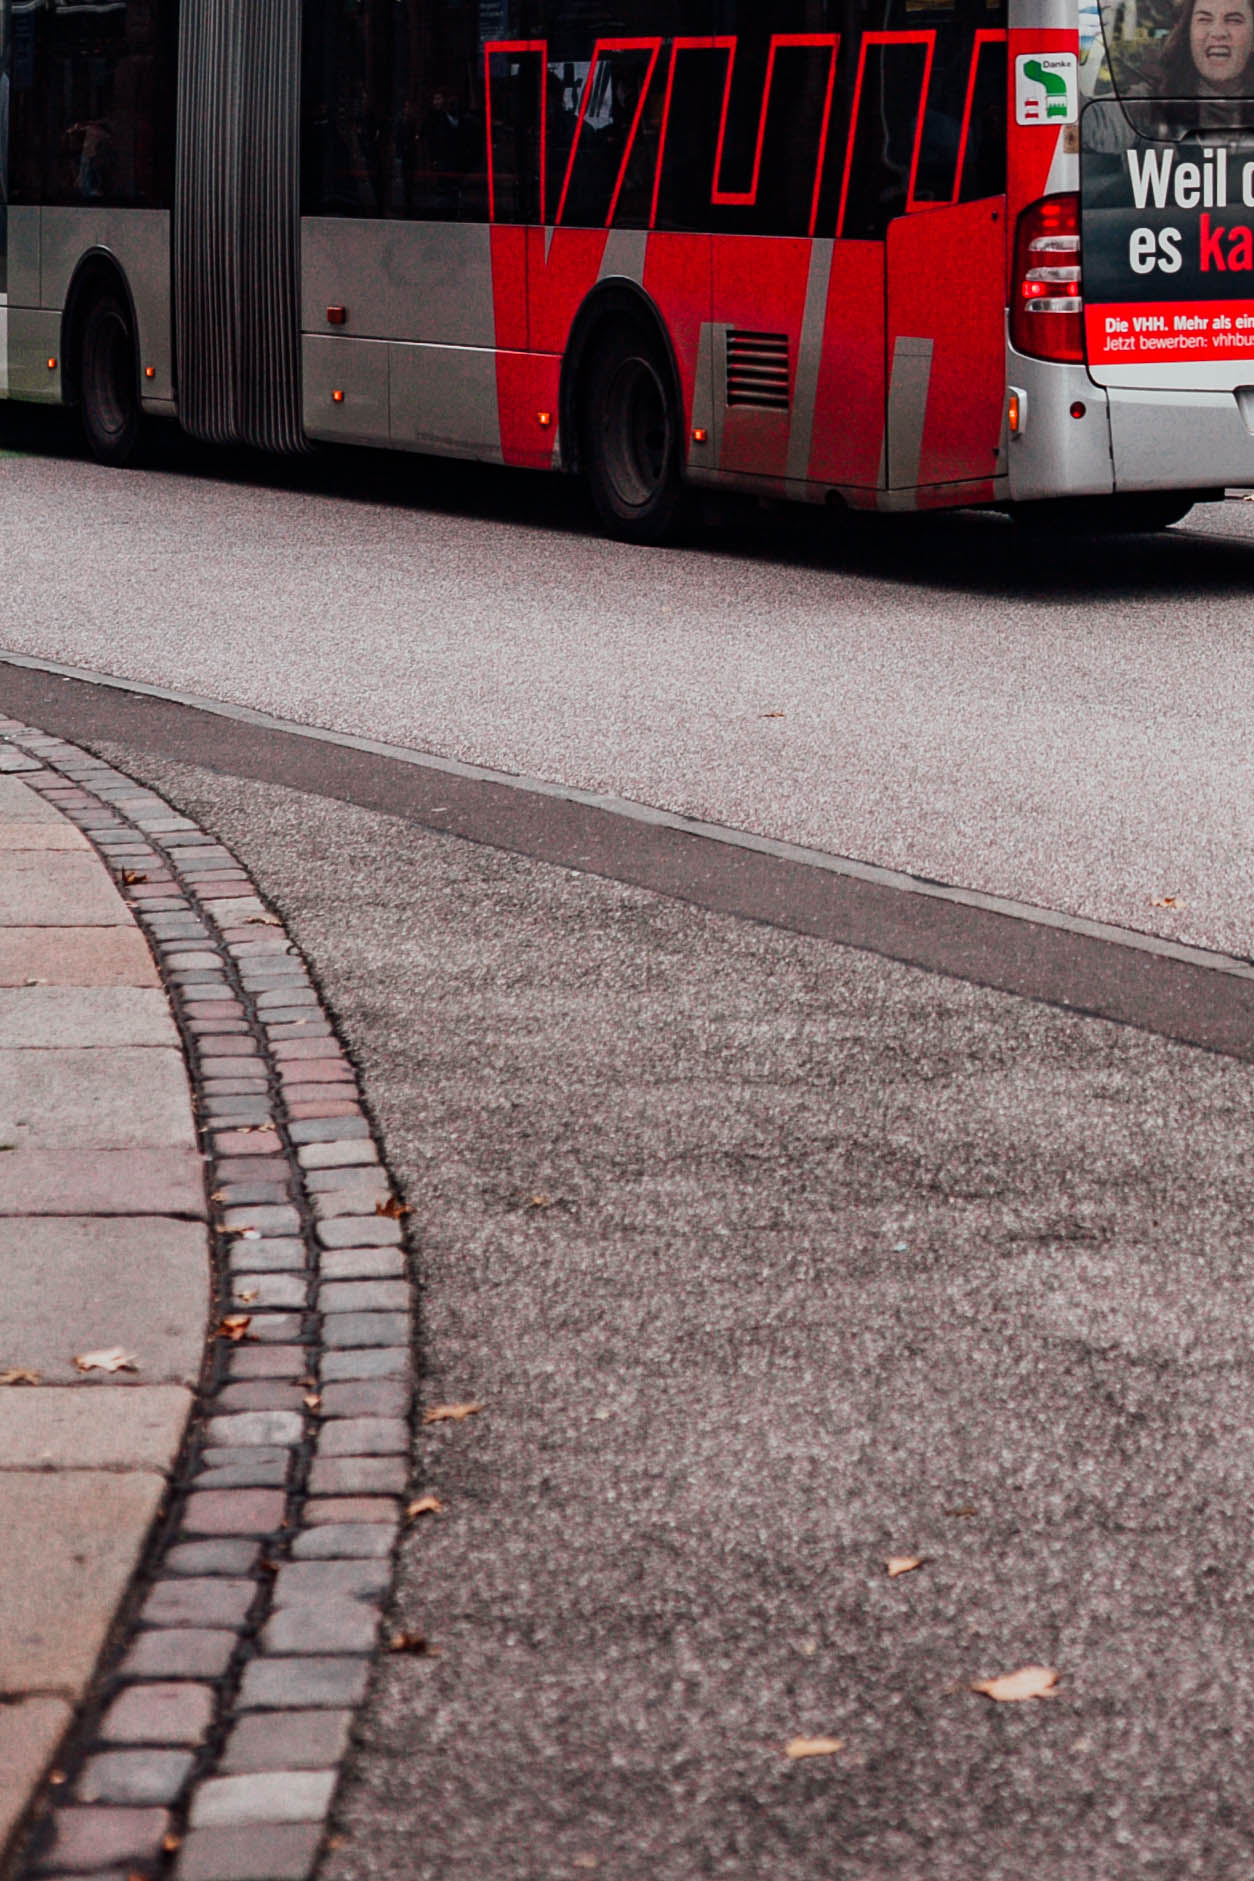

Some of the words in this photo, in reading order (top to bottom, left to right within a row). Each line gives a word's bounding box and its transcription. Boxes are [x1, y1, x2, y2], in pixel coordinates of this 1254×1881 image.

[1126, 147, 1227, 209] Weil
[1129, 227, 1183, 275] es
[1105, 317, 1128, 333] Die
[1133, 316, 1169, 332] VHH.
[1174, 315, 1208, 331] Mehr
[1212, 314, 1232, 330] als
[1103, 335, 1136, 352] Jetzt
[1139, 333, 1208, 350] bewerben:
